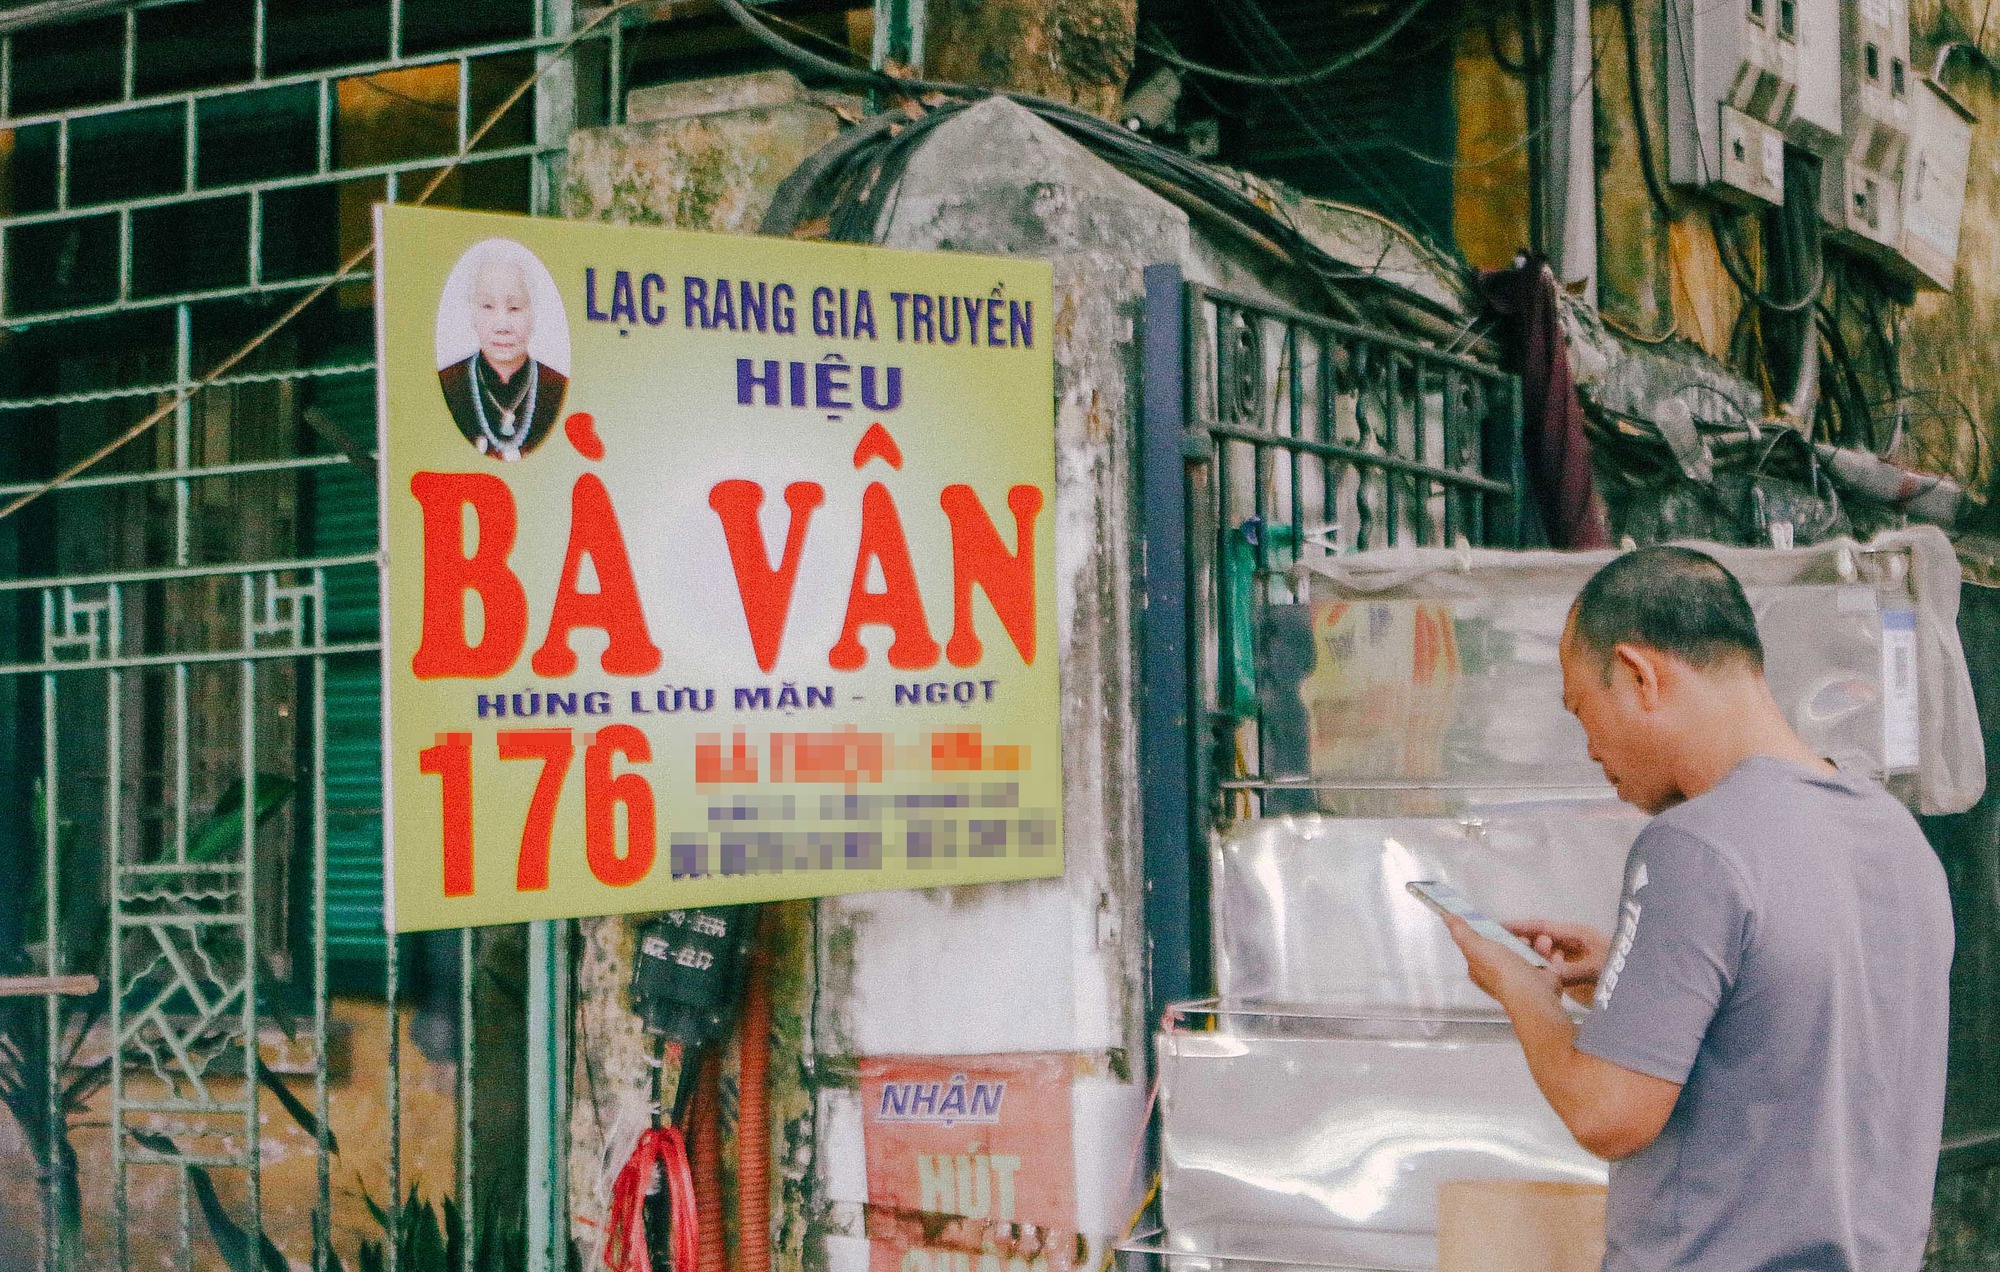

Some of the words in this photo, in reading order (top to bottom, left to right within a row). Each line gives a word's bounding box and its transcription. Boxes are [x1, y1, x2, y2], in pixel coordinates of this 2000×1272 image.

[585, 267, 666, 337] LẠC
[684, 276, 795, 335] RANG
[812, 286, 877, 340] GIA
[736, 353, 902, 420] HIỆU
[411, 413, 662, 679] BÀ
[709, 424, 1042, 671] VÂN
[478, 688, 612, 718] HÚNG
[735, 683, 833, 715] MẶN
[895, 680, 998, 709] NGỌT
[420, 725, 654, 896] 176
[881, 1075, 1003, 1125] NHẬN
[918, 1141, 1021, 1220] HÚT
